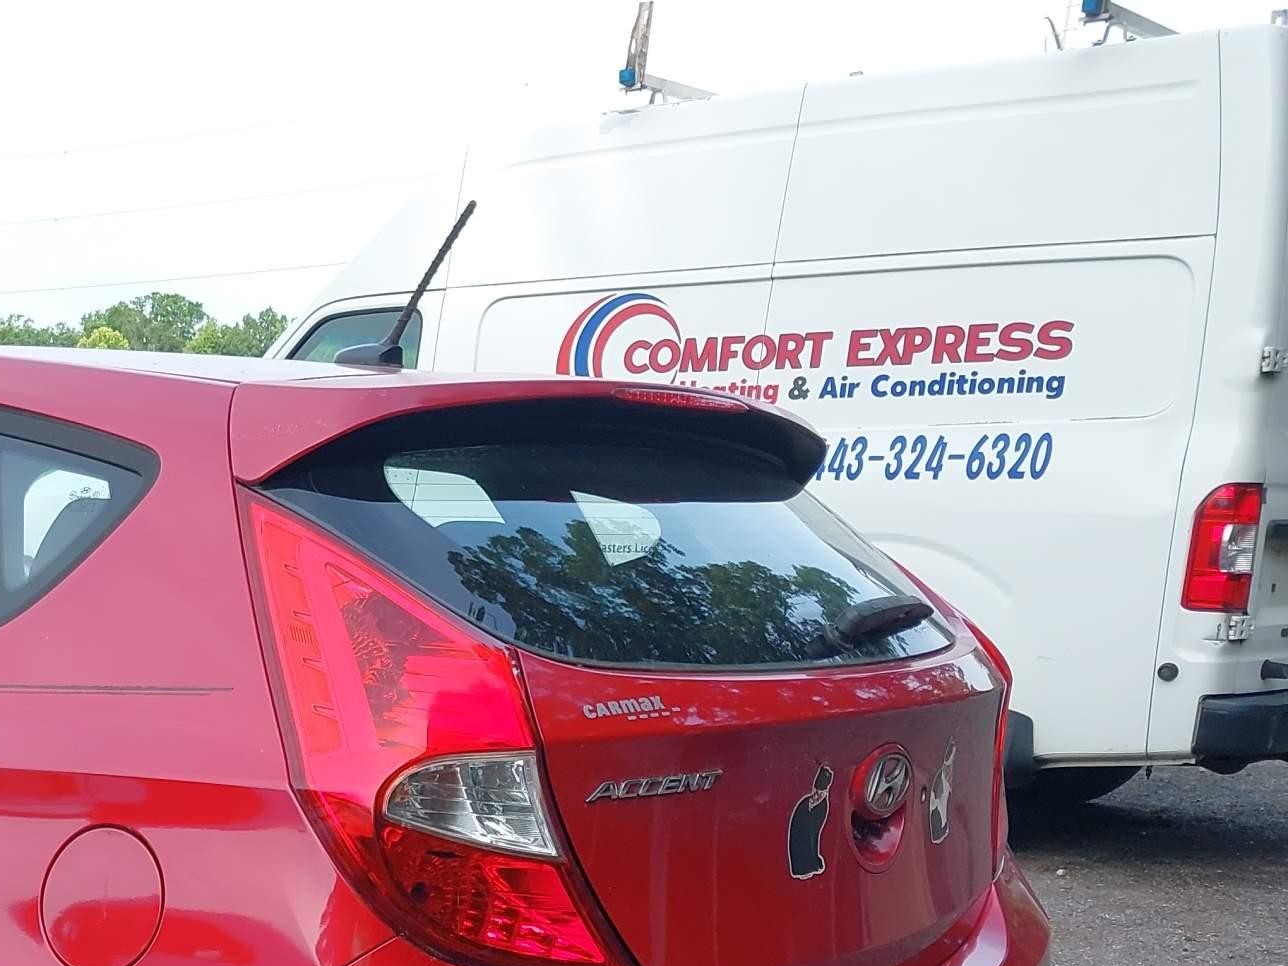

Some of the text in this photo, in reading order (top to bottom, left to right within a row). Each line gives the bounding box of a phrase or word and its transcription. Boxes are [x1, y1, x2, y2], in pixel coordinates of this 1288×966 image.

[623, 320, 1075, 375] COMFORT EXPRESS
[679, 369, 1066, 405] ting & Air Conditioning
[601, 543, 632, 554] asters
[585, 768, 724, 802] ACCENT
